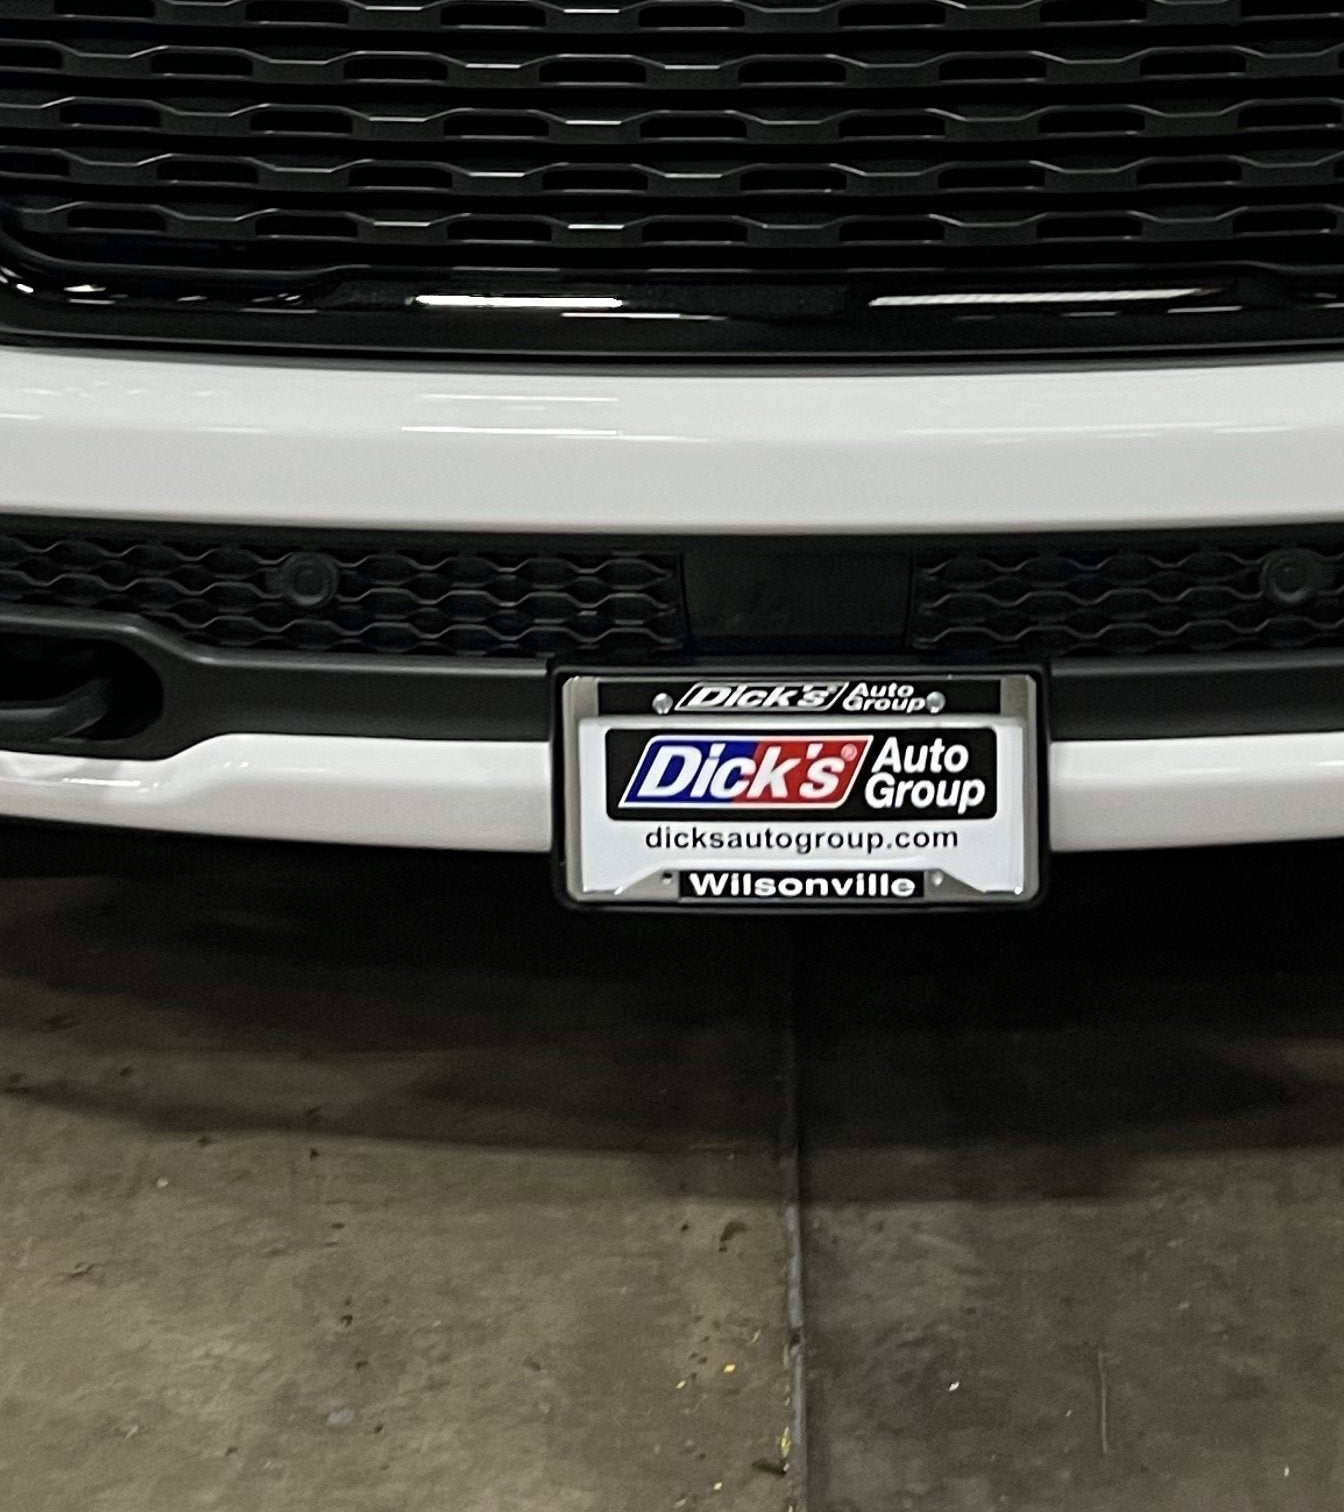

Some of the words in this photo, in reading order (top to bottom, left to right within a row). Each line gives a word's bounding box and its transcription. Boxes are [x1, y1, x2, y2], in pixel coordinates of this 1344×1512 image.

[686, 685, 830, 708] Dick's
[842, 695, 926, 713] Group
[851, 682, 915, 699] Auto
[871, 737, 970, 773] Auto
[636, 743, 847, 800] Dick's
[864, 772, 986, 814] Group
[645, 826, 959, 855] dicksautogroup.com
[689, 872, 916, 898] Wilsonville
